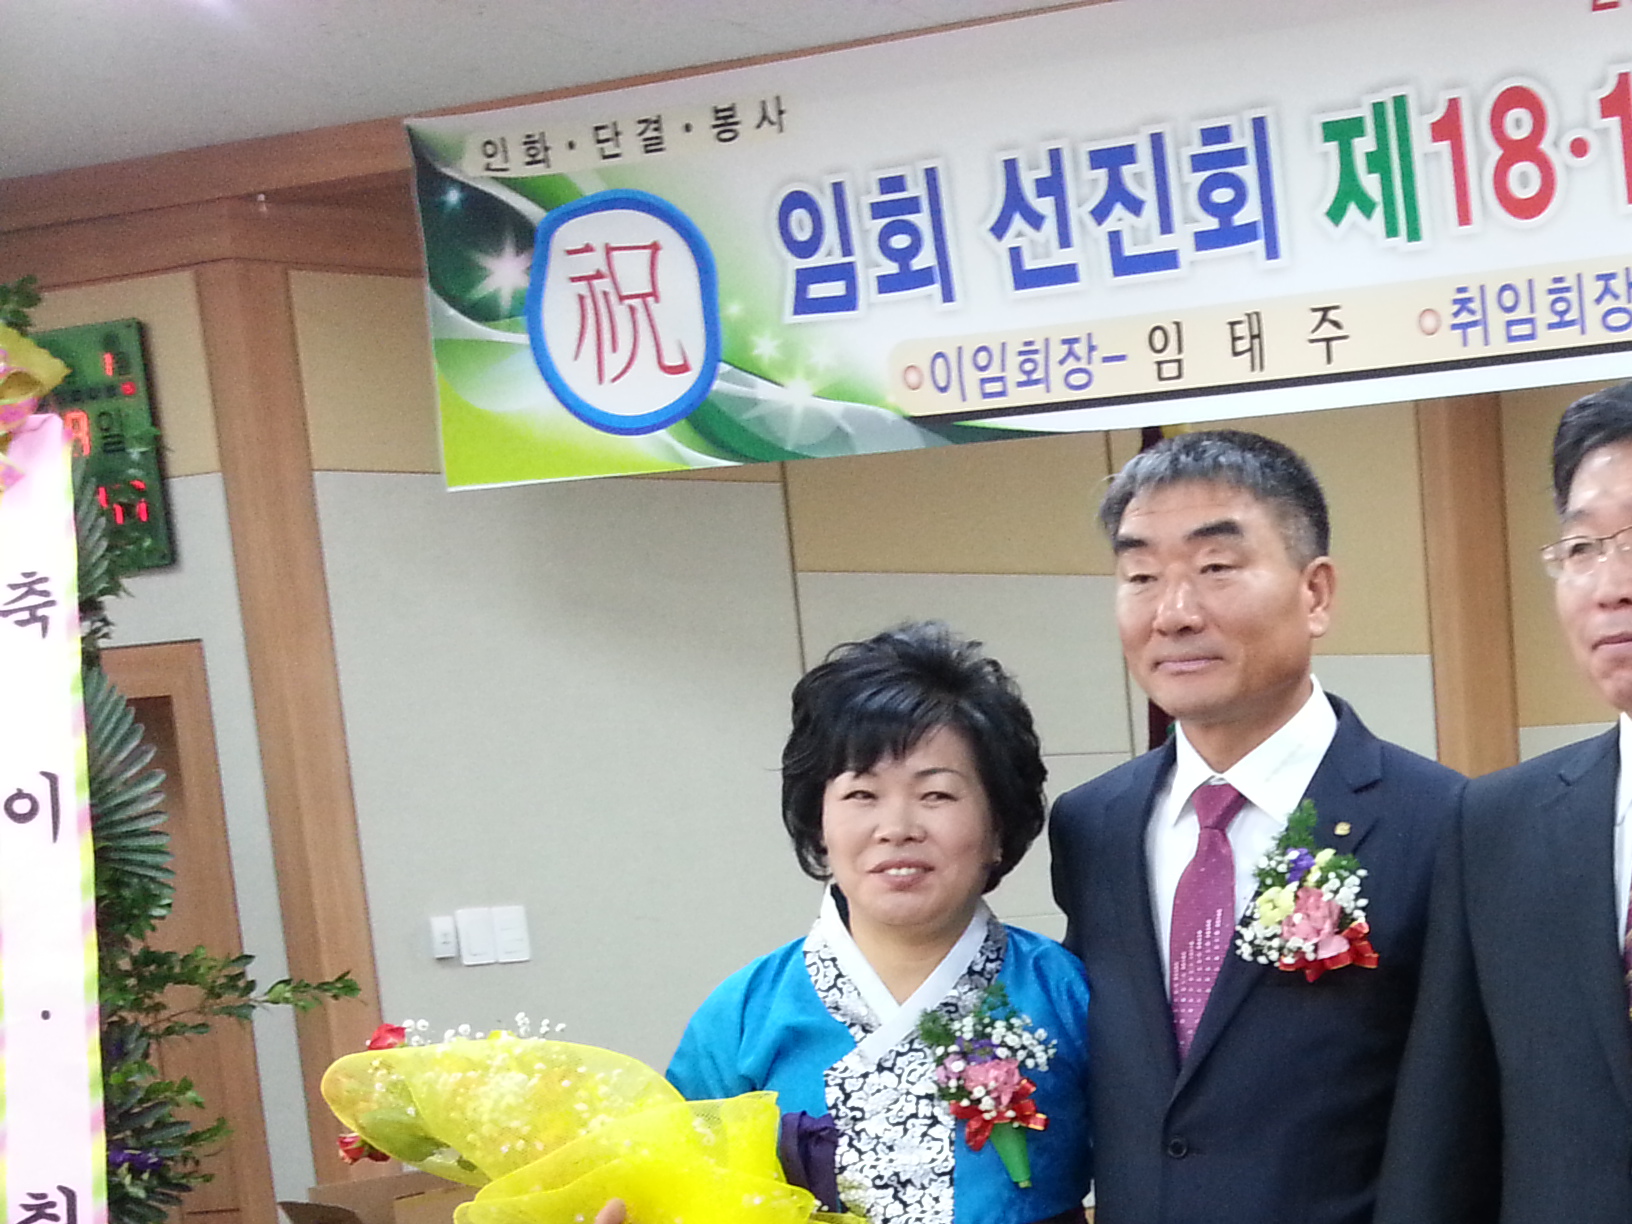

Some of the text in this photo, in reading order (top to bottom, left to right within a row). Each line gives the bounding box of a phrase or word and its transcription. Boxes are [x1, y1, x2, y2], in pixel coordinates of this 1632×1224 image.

[777, 166, 957, 317] 임회
[988, 114, 1282, 293] 선진회
[564, 239, 694, 386] 祝
